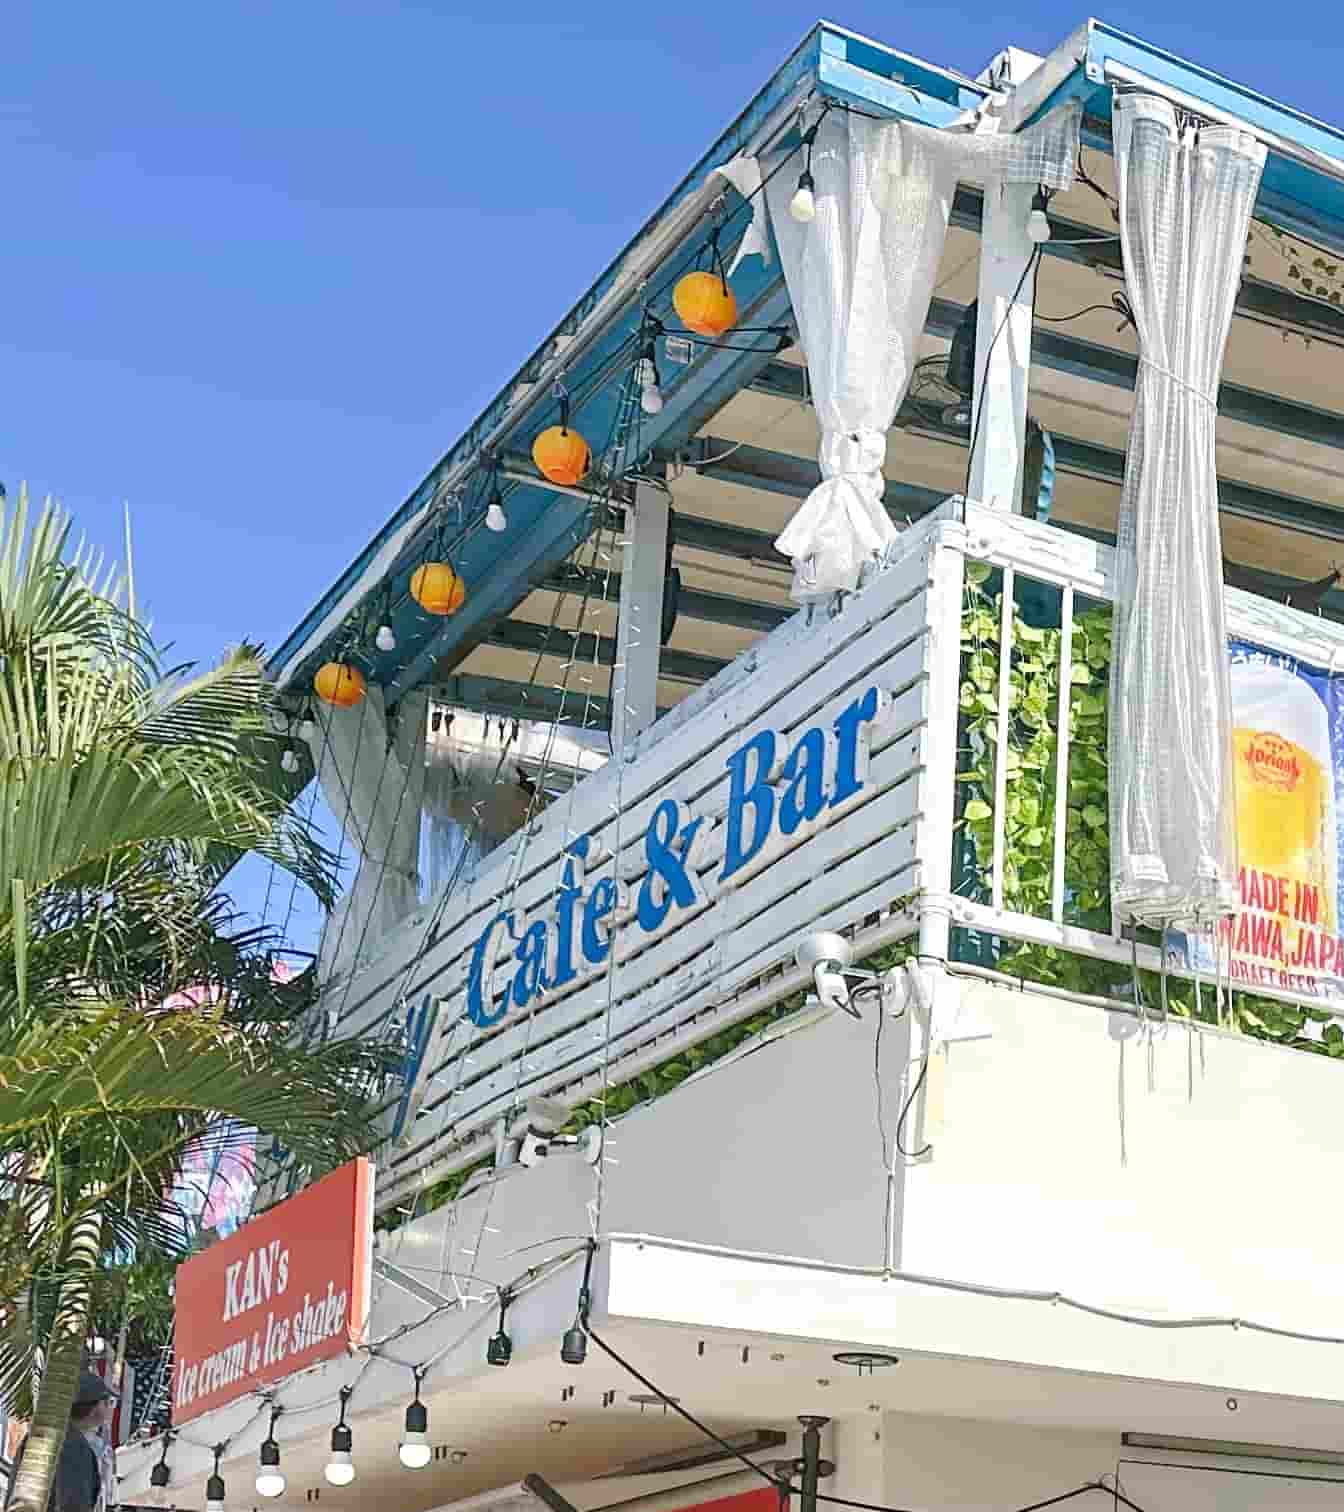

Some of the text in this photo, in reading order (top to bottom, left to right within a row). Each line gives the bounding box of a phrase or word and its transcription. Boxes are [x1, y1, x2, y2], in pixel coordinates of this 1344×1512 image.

[637, 799, 705, 932] &
[720, 686, 880, 882] Bar
[1295, 880, 1318, 925] IN
[176, 1357, 197, 1408] Ice
[198, 1337, 247, 1394] cream
[263, 1312, 290, 1367] Ice
[291, 1281, 348, 1348] shake
